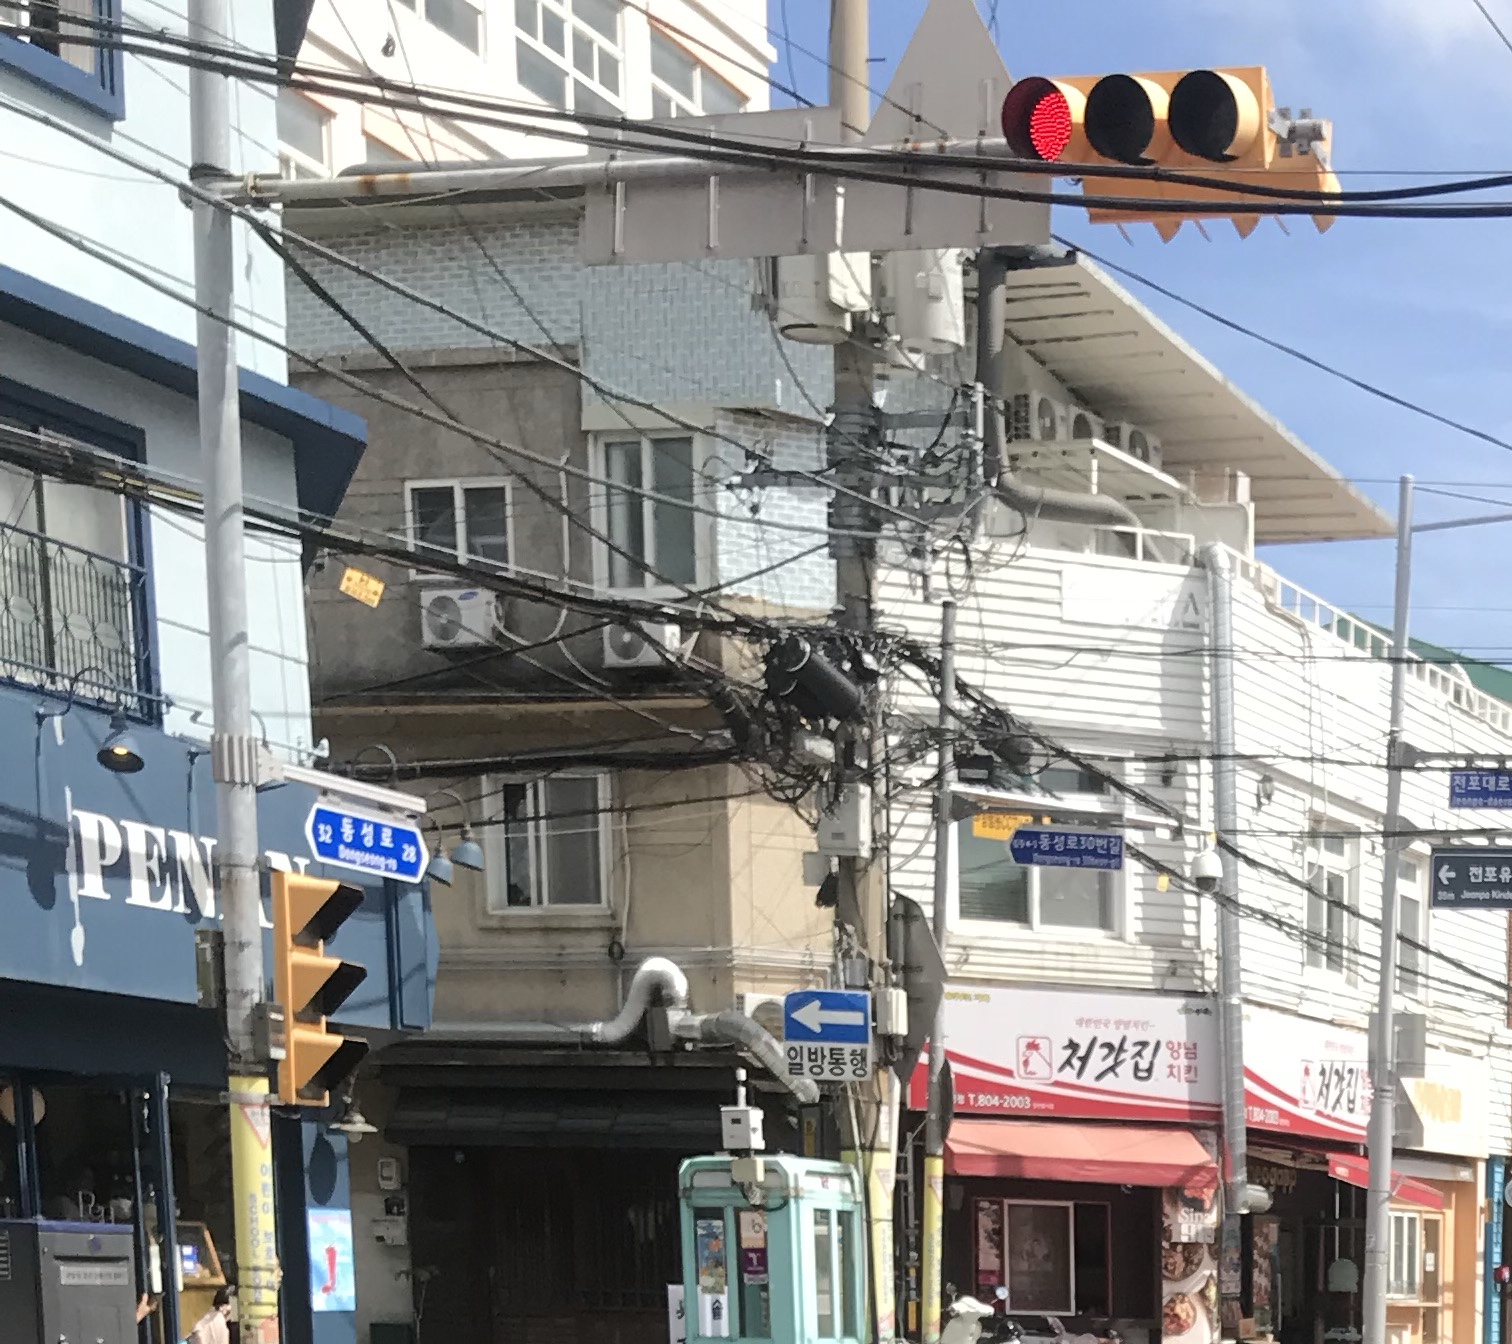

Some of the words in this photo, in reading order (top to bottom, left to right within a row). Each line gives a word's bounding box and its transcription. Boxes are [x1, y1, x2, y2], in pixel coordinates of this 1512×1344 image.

[340, 816, 395, 848] 동성로
[72, 810, 311, 929] PEN
[787, 1045, 868, 1078] 일방통행
[1057, 1034, 1161, 1083] 처갓집
[1166, 1040, 1198, 1060] 양념
[1167, 1063, 1199, 1084] 치킨
